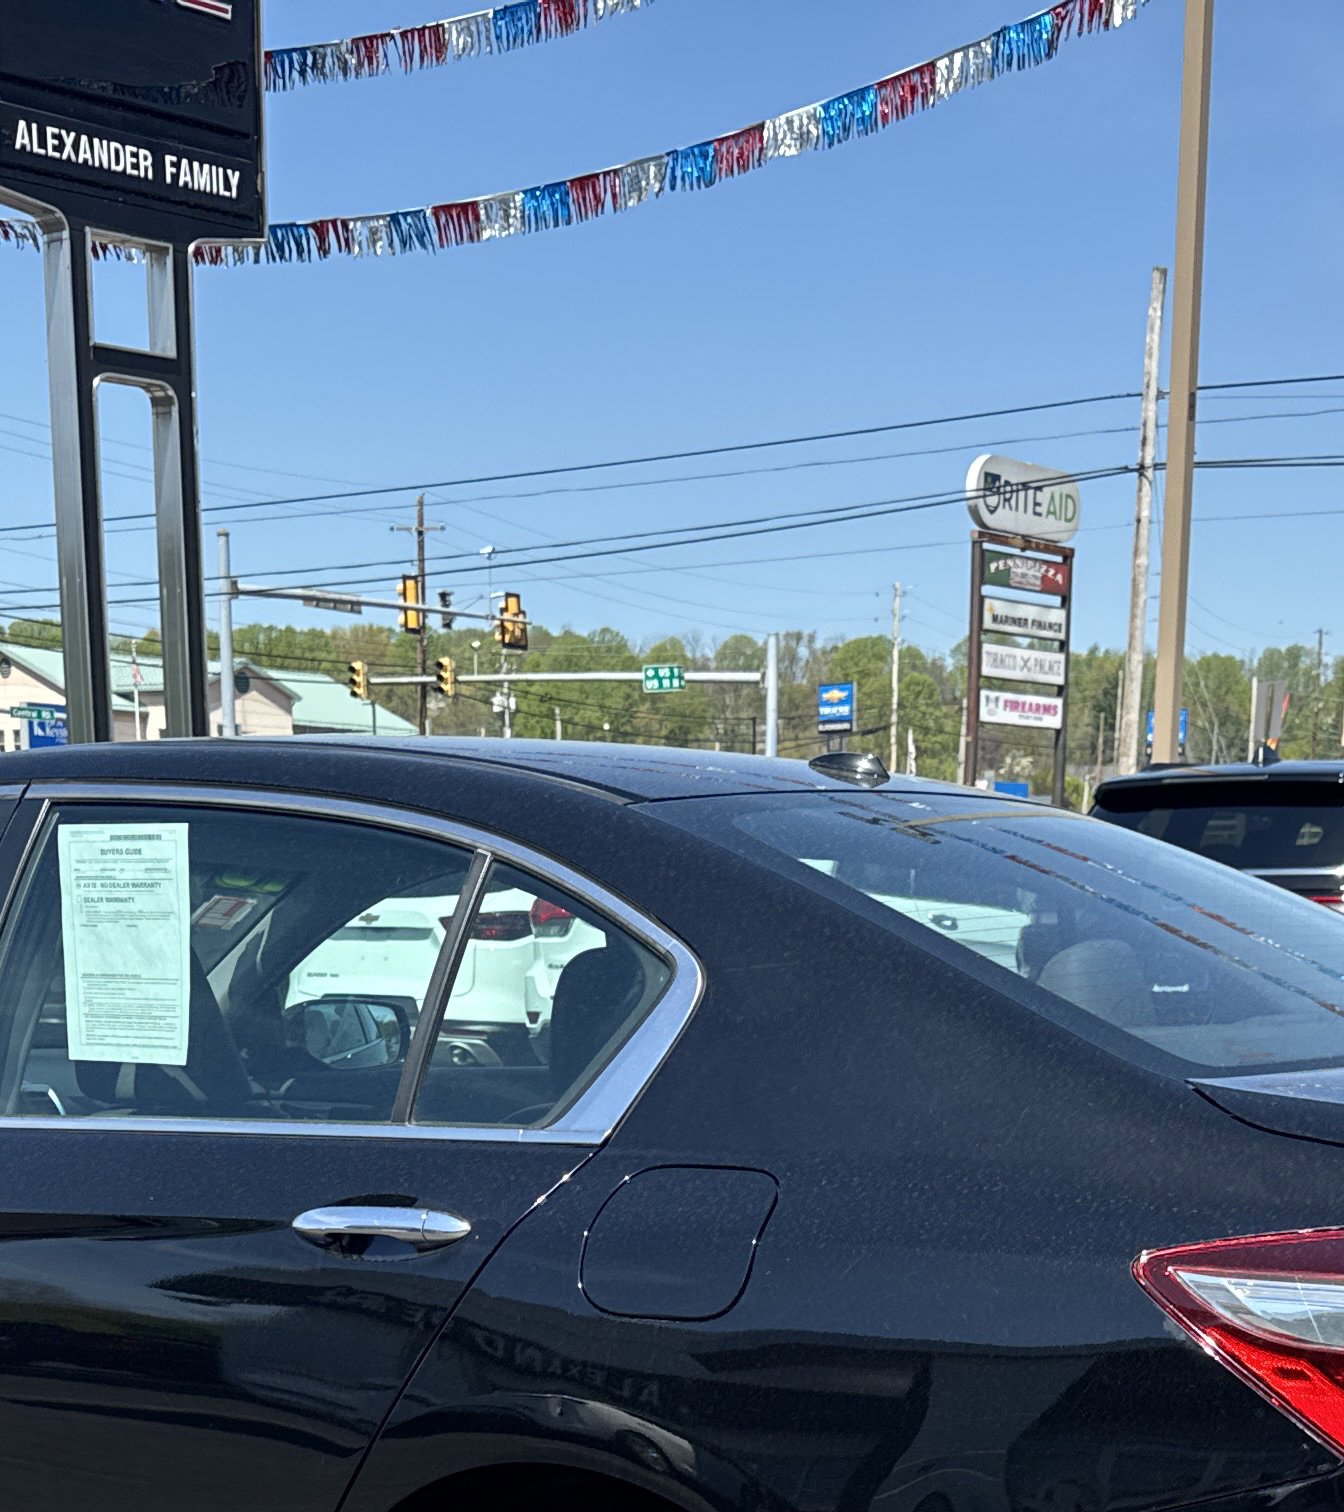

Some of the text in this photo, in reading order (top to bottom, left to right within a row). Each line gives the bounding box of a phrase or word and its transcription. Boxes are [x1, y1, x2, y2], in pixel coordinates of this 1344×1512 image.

[14, 119, 240, 199] ALEXANDER FAMILY
[1002, 480, 1077, 524] RITE AID
[991, 613, 1063, 633] MARINER FINANCE
[1003, 699, 1058, 717] FIREARMS
[100, 848, 124, 856] BUYERS
[83, 896, 104, 904] DEALER
